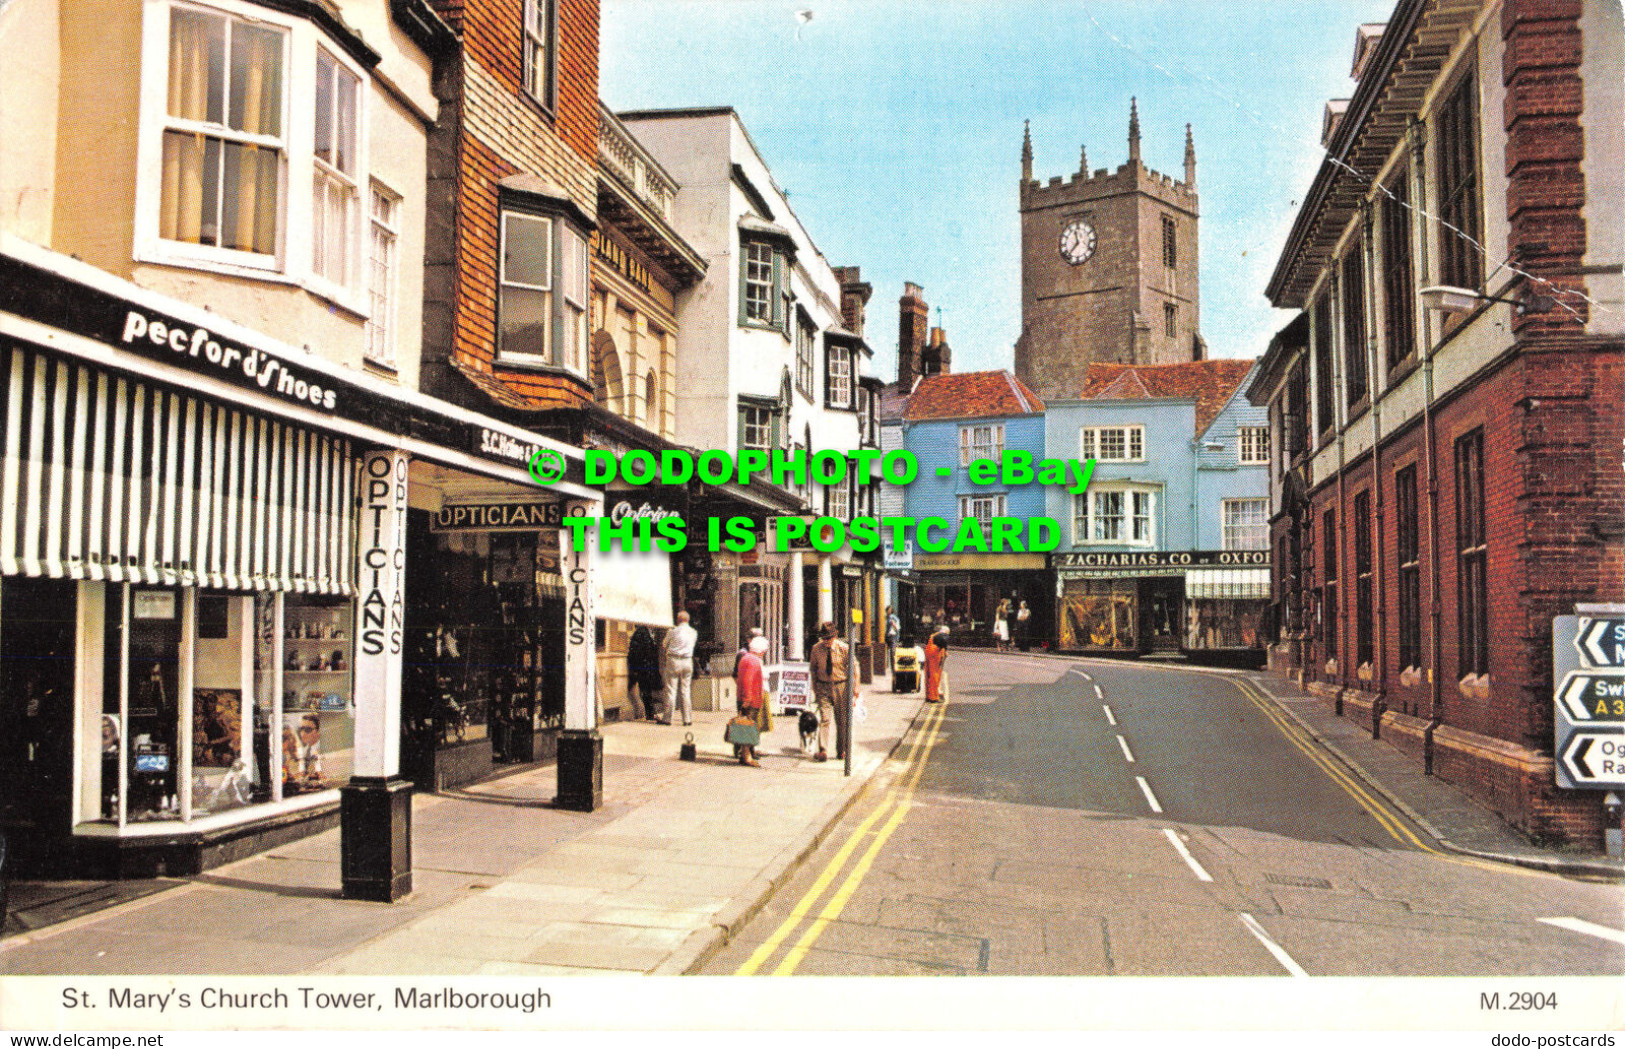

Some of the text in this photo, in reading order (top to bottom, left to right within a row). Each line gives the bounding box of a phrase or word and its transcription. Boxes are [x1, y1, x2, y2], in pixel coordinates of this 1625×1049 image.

[439, 504, 560, 526] OPTICIANS
[362, 455, 391, 655] OPTICIANS
[391, 458, 406, 655] OPTICIANS
[1066, 553, 1158, 565] ZACHARIAS
[1169, 553, 1191, 565] CO
[569, 505, 587, 646] OICIANS
[1601, 741, 1625, 758] Og
[1603, 760, 1625, 774] Ra
